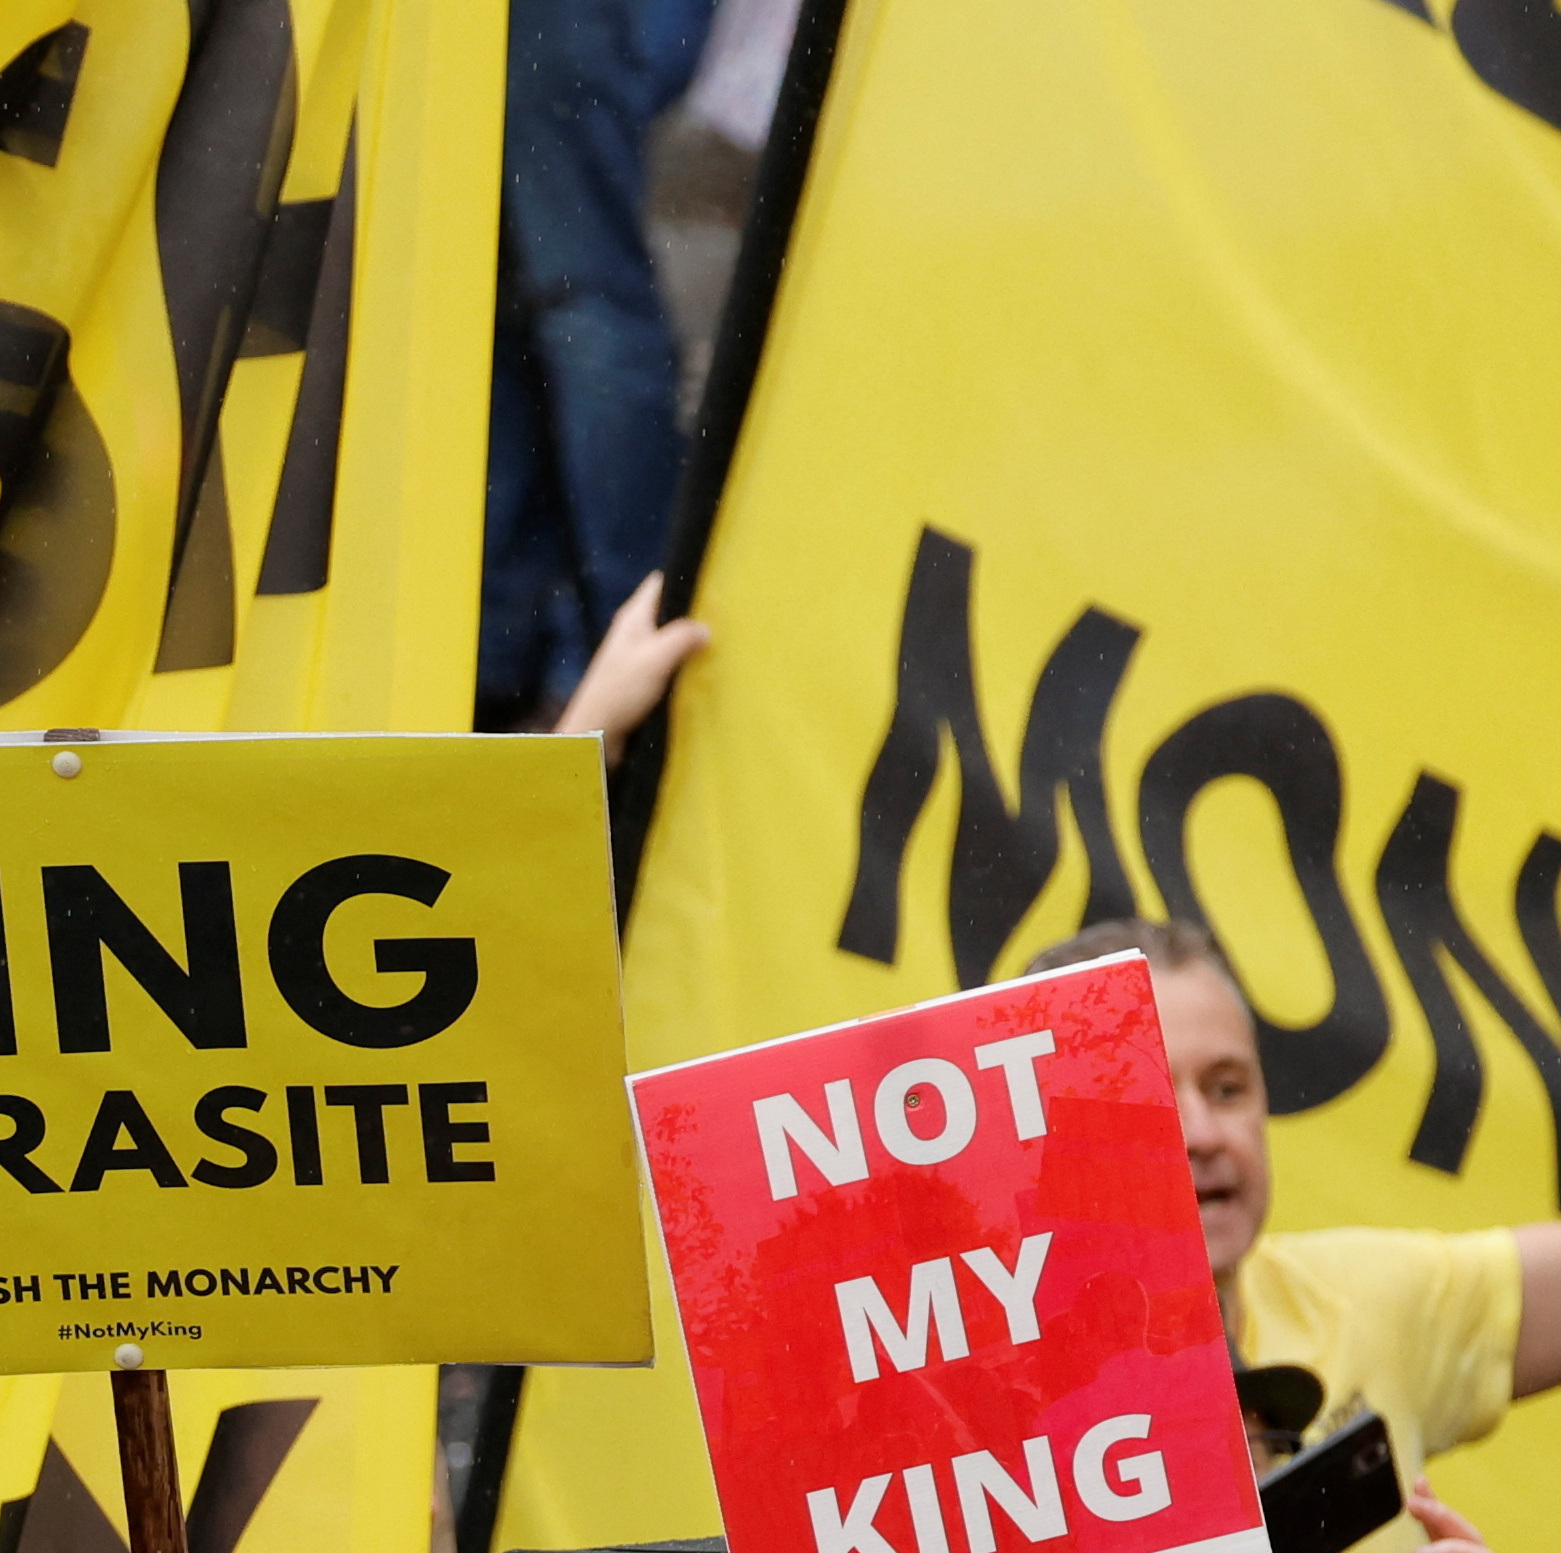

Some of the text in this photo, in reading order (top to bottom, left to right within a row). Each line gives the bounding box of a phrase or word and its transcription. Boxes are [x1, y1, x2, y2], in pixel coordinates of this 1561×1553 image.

[752, 1028, 1057, 1201] NOT
[52, 1271, 133, 1301] THE
[146, 1265, 401, 1299] MONARCHY
[834, 1231, 1054, 1384] MY
[57, 1320, 203, 1342] #NotMyKing
